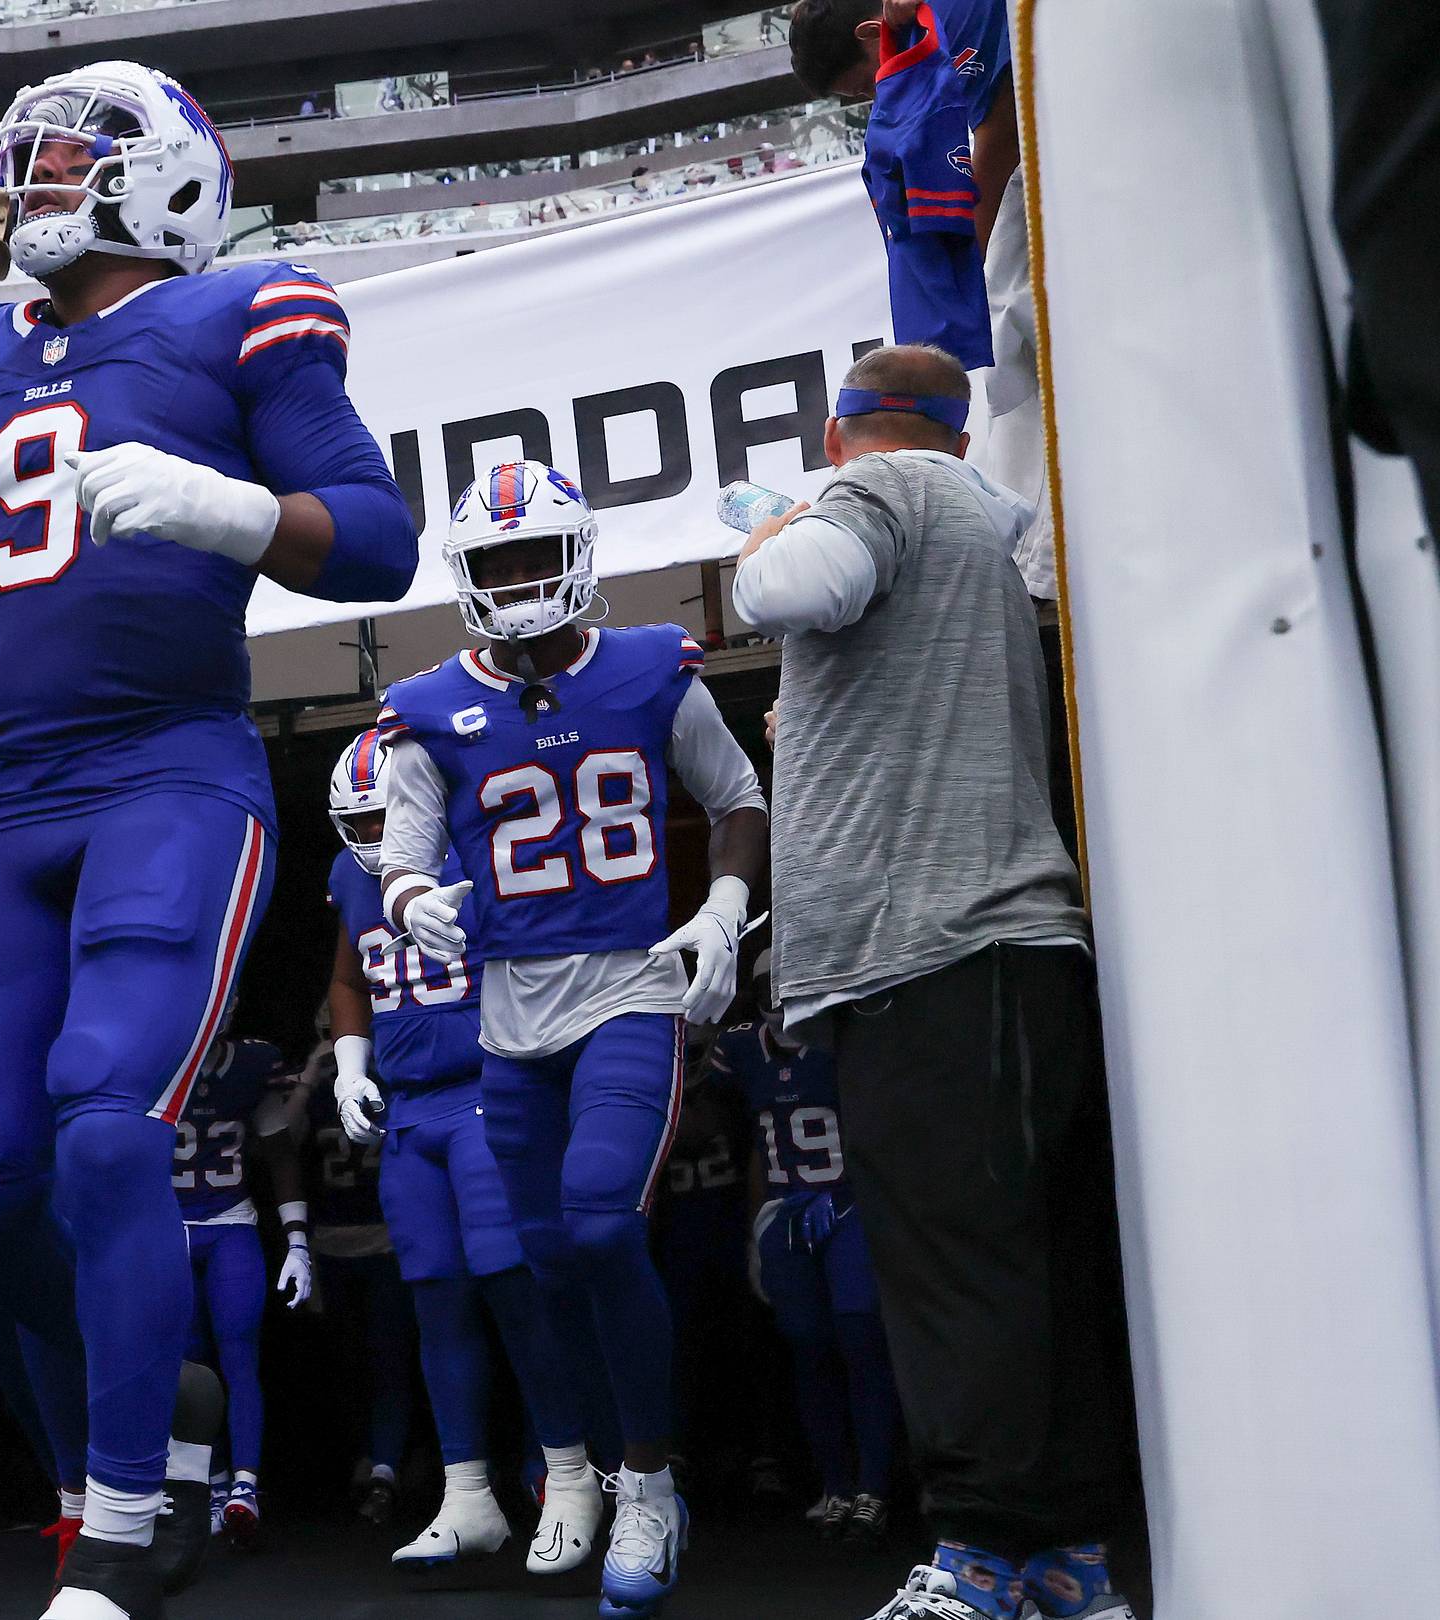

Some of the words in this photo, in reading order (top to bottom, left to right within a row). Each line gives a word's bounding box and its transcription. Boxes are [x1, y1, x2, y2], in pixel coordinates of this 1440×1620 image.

[24, 379, 73, 402] BILLS
[390, 338, 885, 539] NDA
[451, 705, 488, 736] C
[535, 731, 580, 750] BILLS
[476, 747, 658, 900] 28
[357, 924, 472, 1014] 90
[171, 1120, 245, 1189] 23
[758, 1105, 845, 1185] 19
